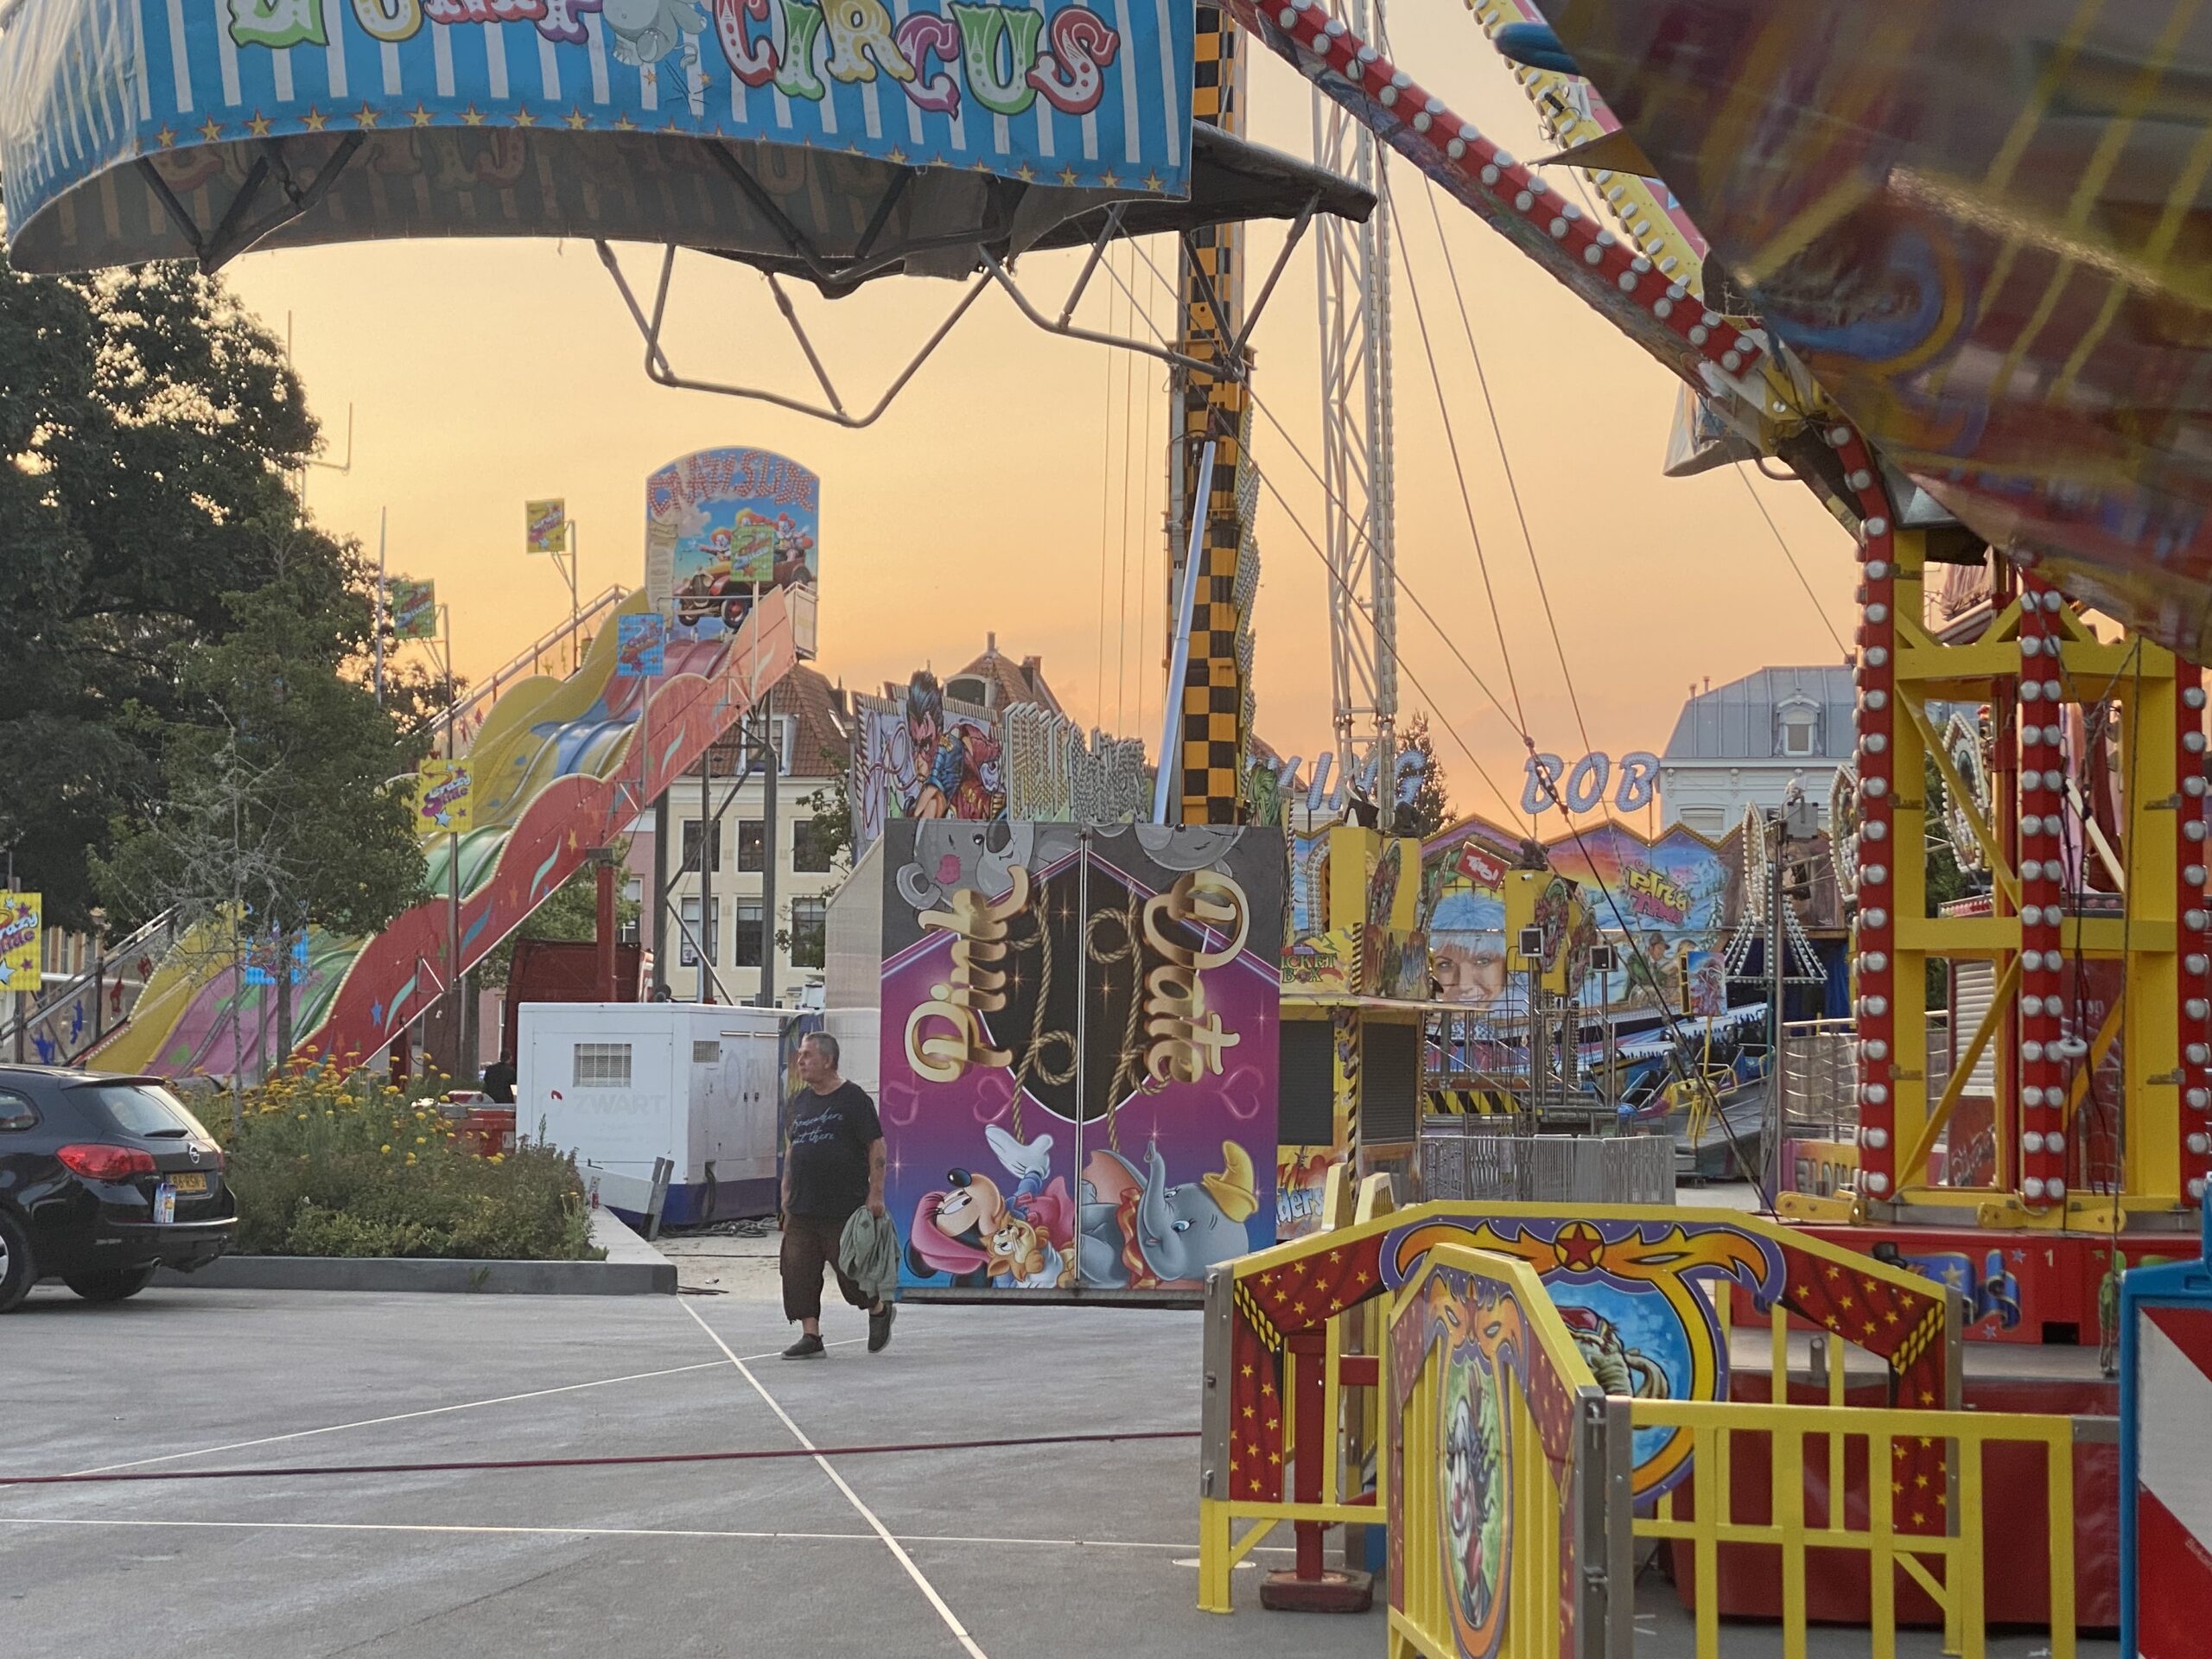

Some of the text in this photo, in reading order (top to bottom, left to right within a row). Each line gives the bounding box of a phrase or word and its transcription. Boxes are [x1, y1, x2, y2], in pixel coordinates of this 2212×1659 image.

[715, 0, 1120, 120] CIRCUS
[734, 449, 818, 512] SLIDE
[1521, 751, 1661, 815] BOB
[0, 912, 38, 939] razy
[0, 930, 35, 954] lide
[904, 864, 1030, 1084] Pink
[1143, 869, 1249, 1084] Date
[1280, 953, 1338, 969] ICKET
